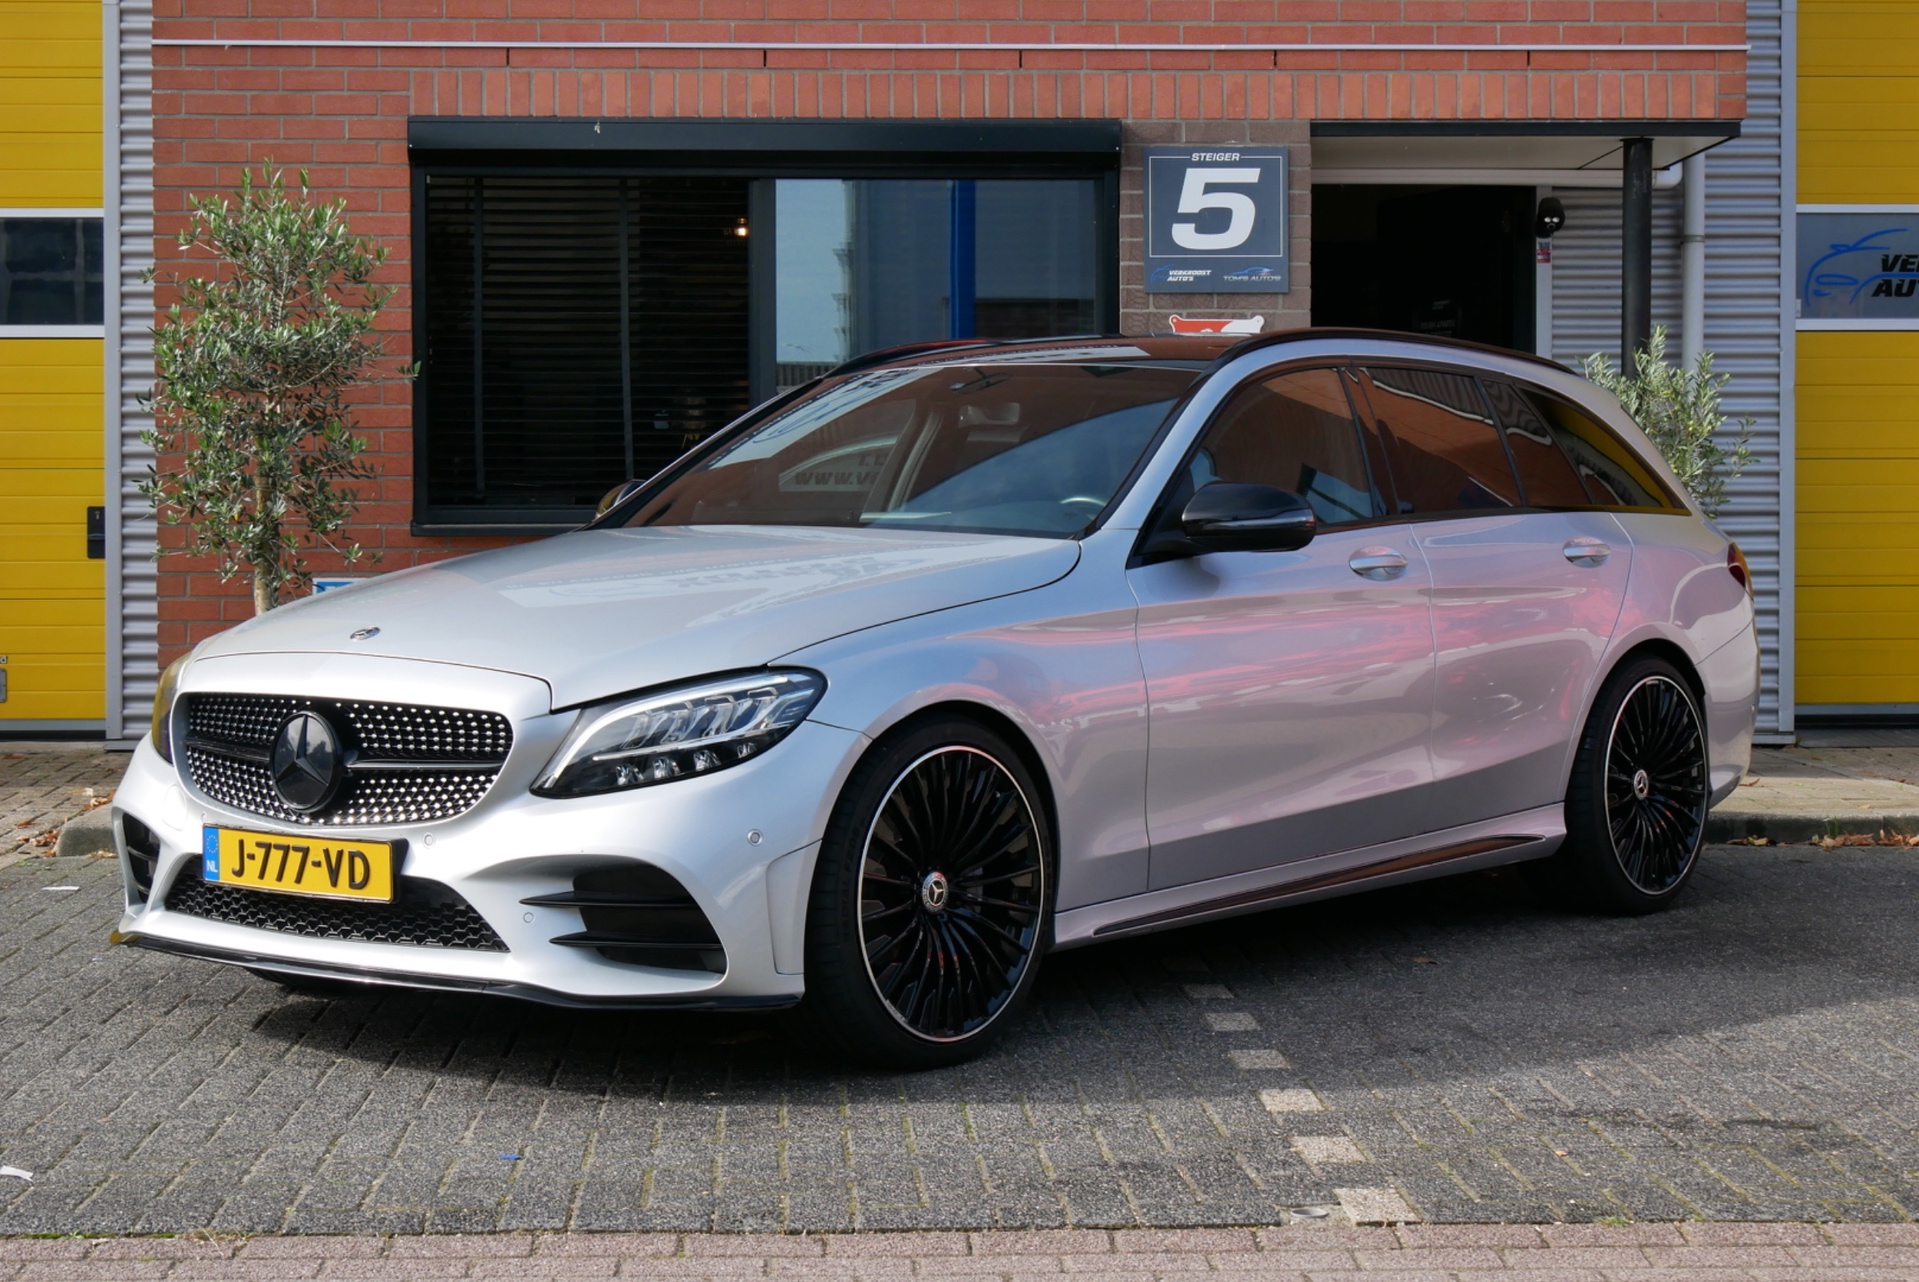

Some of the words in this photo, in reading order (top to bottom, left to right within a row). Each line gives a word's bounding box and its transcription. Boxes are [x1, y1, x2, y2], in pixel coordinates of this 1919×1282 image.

[1191, 153, 1241, 162] STEIGER
[1171, 168, 1261, 250] 5
[1881, 254, 1919, 272] VE
[1871, 279, 1919, 297] AU
[206, 859, 218, 873] NL
[231, 838, 370, 890] J-777-VD
